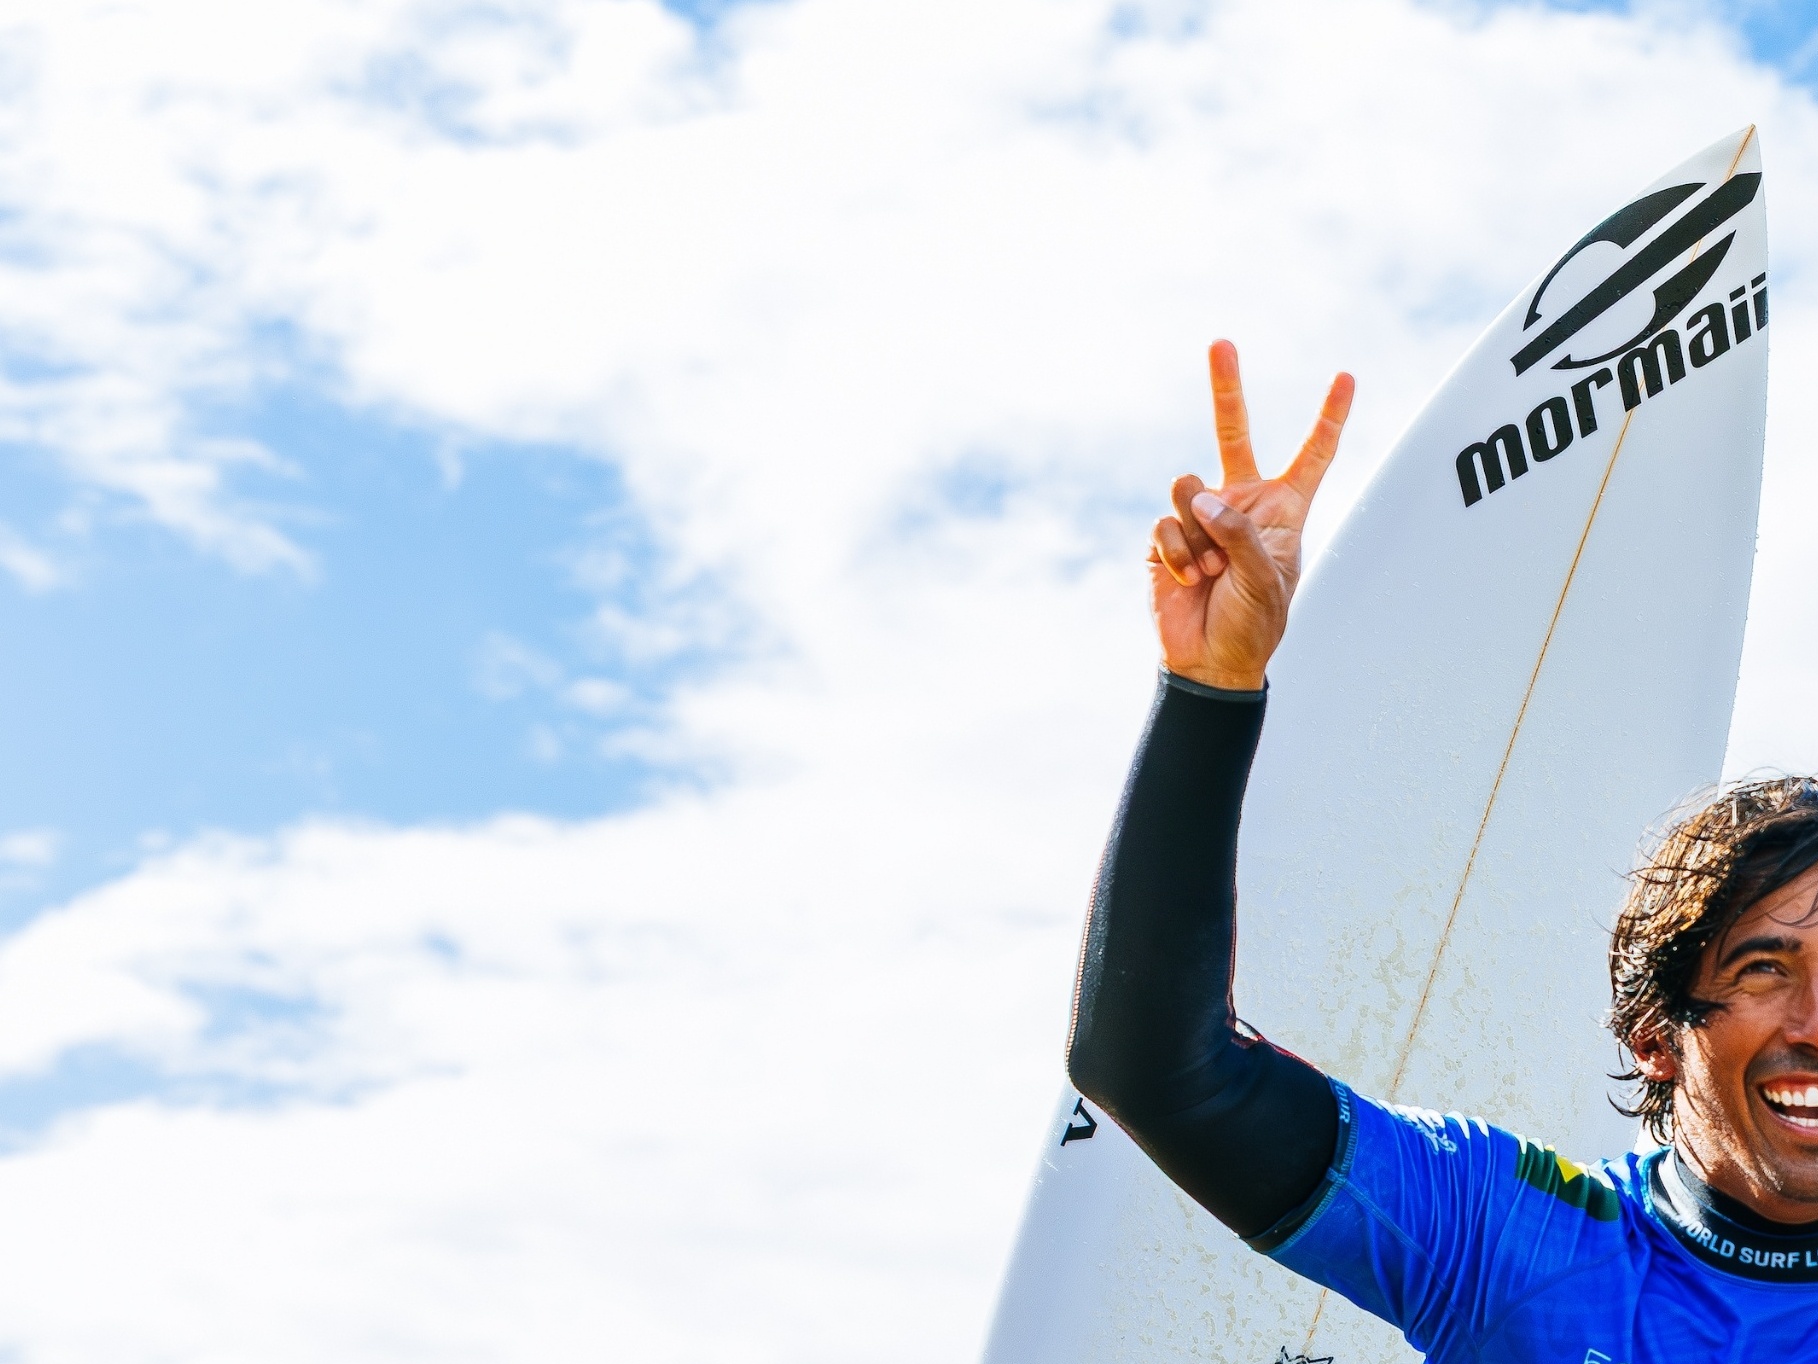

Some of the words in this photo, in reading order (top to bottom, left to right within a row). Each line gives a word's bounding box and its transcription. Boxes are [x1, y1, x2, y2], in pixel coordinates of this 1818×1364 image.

[1455, 271, 1769, 508] mormaii
[1674, 1211, 1735, 1258] WORLD
[1738, 1246, 1800, 1269] SURF
